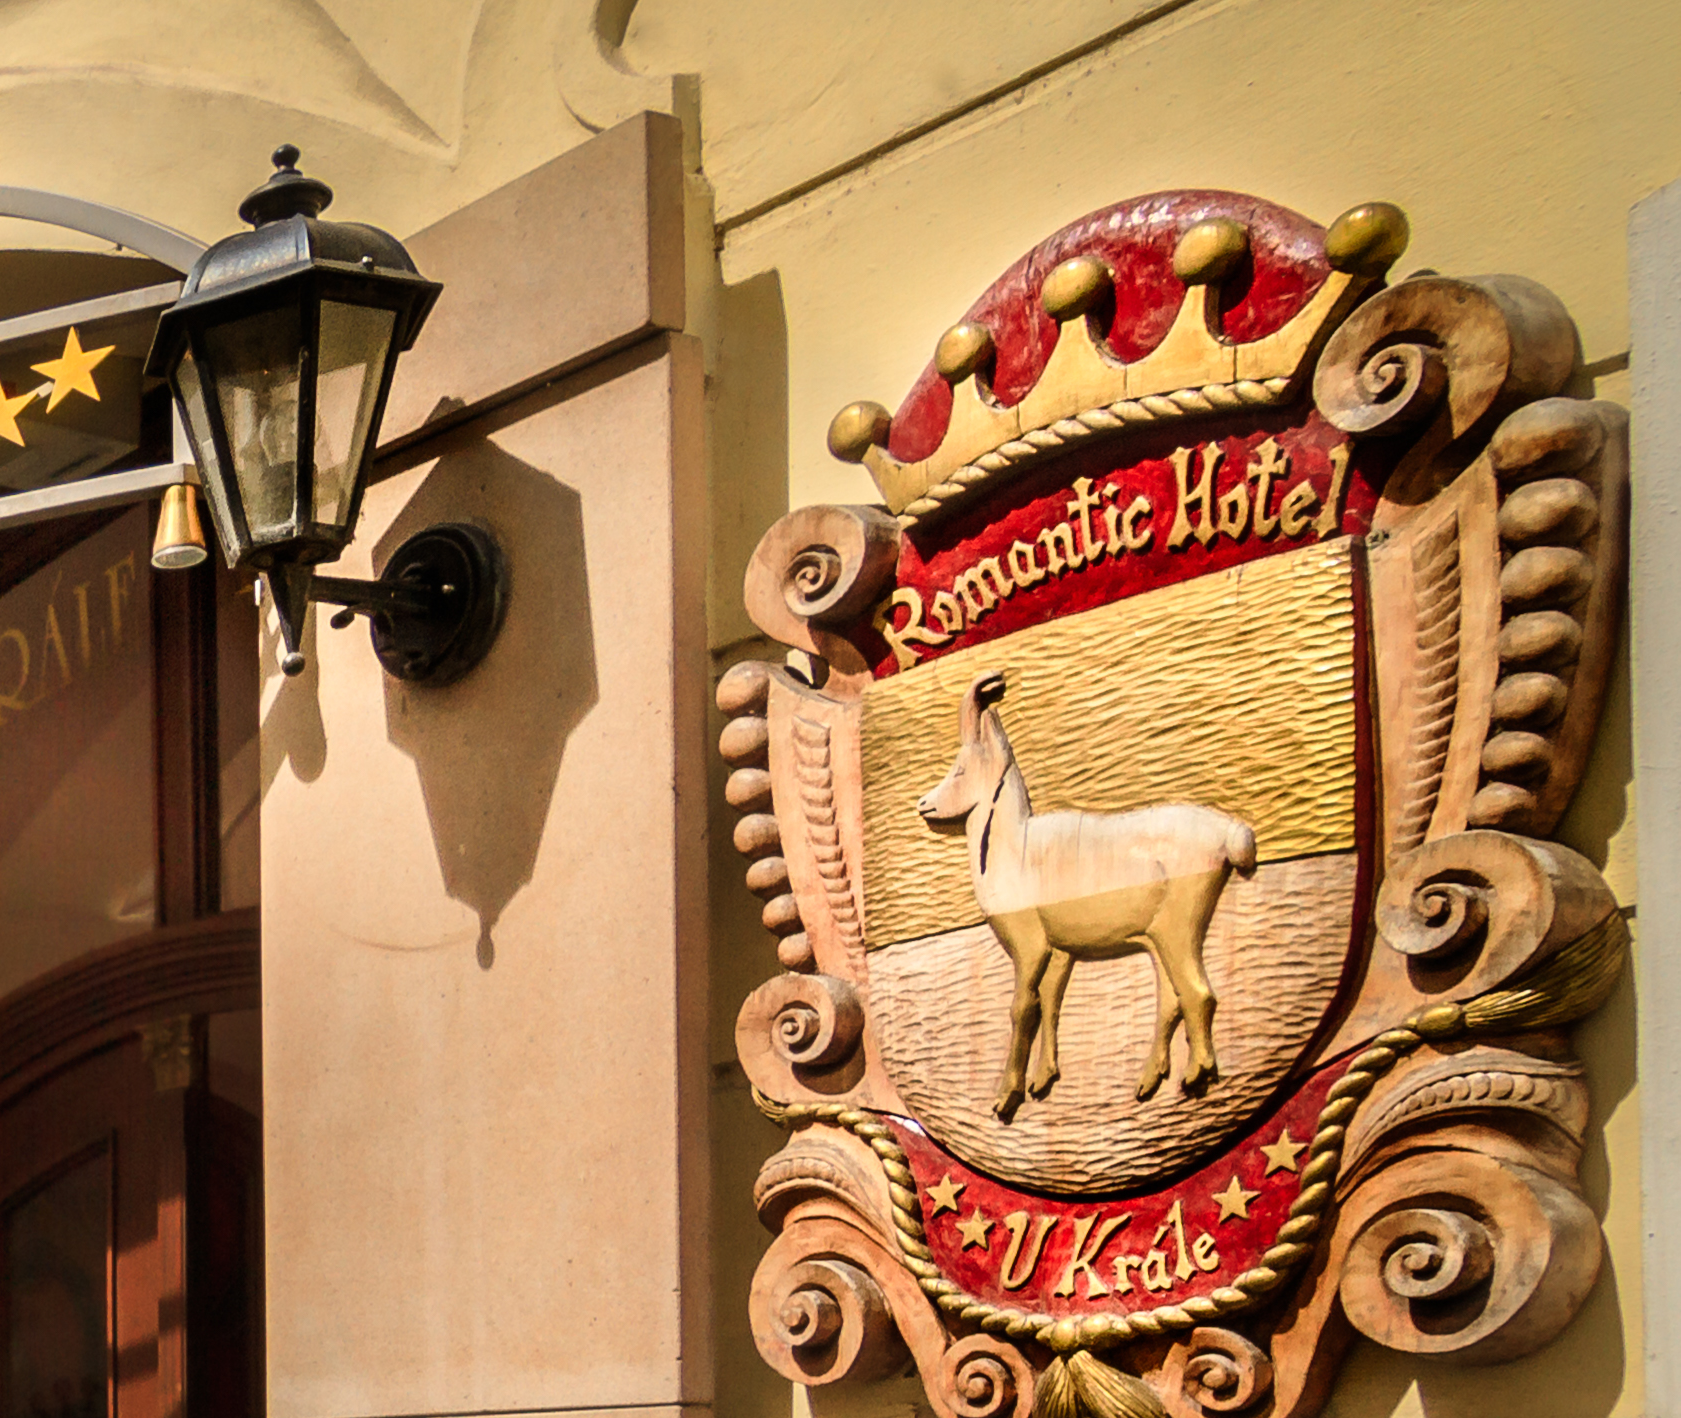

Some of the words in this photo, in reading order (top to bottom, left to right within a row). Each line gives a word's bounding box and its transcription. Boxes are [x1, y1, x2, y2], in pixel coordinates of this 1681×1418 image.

[874, 476, 1153, 674] Romantic
[1166, 435, 1353, 551] Hotel
[1001, 1210, 1059, 1291] U
[1054, 1200, 1221, 1301] Krále
